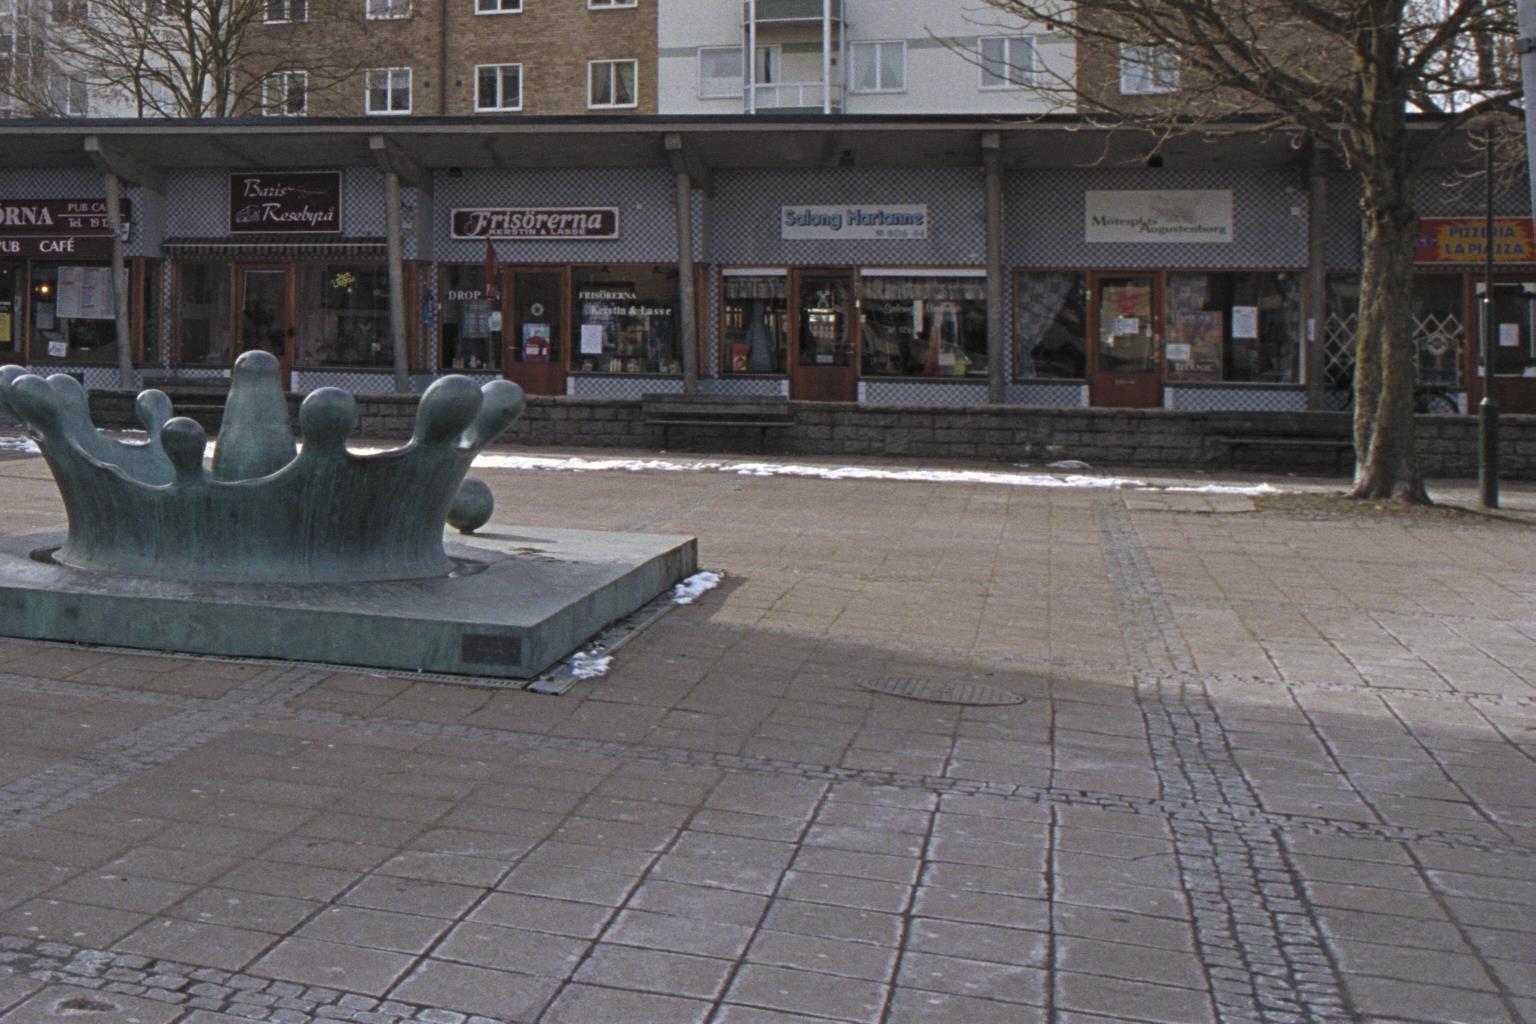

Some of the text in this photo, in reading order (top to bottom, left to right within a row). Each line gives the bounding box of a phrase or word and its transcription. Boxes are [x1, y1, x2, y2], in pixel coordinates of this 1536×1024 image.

[244, 178, 287, 197] Baris
[67, 202, 107, 213] PUB CA
[262, 203, 335, 225] Resebyrå
[784, 209, 925, 230] Salong Marianne
[465, 210, 602, 236] Frisörerna
[489, 228, 537, 236] KERSTIN
[1139, 224, 1227, 236] Augustenborg
[39, 236, 75, 253] CAFÉ
[1445, 243, 1464, 255] LA
[448, 290, 482, 301] DROP
[578, 289, 637, 300] FRISÖRERNA
[640, 305, 672, 316] Lasse
